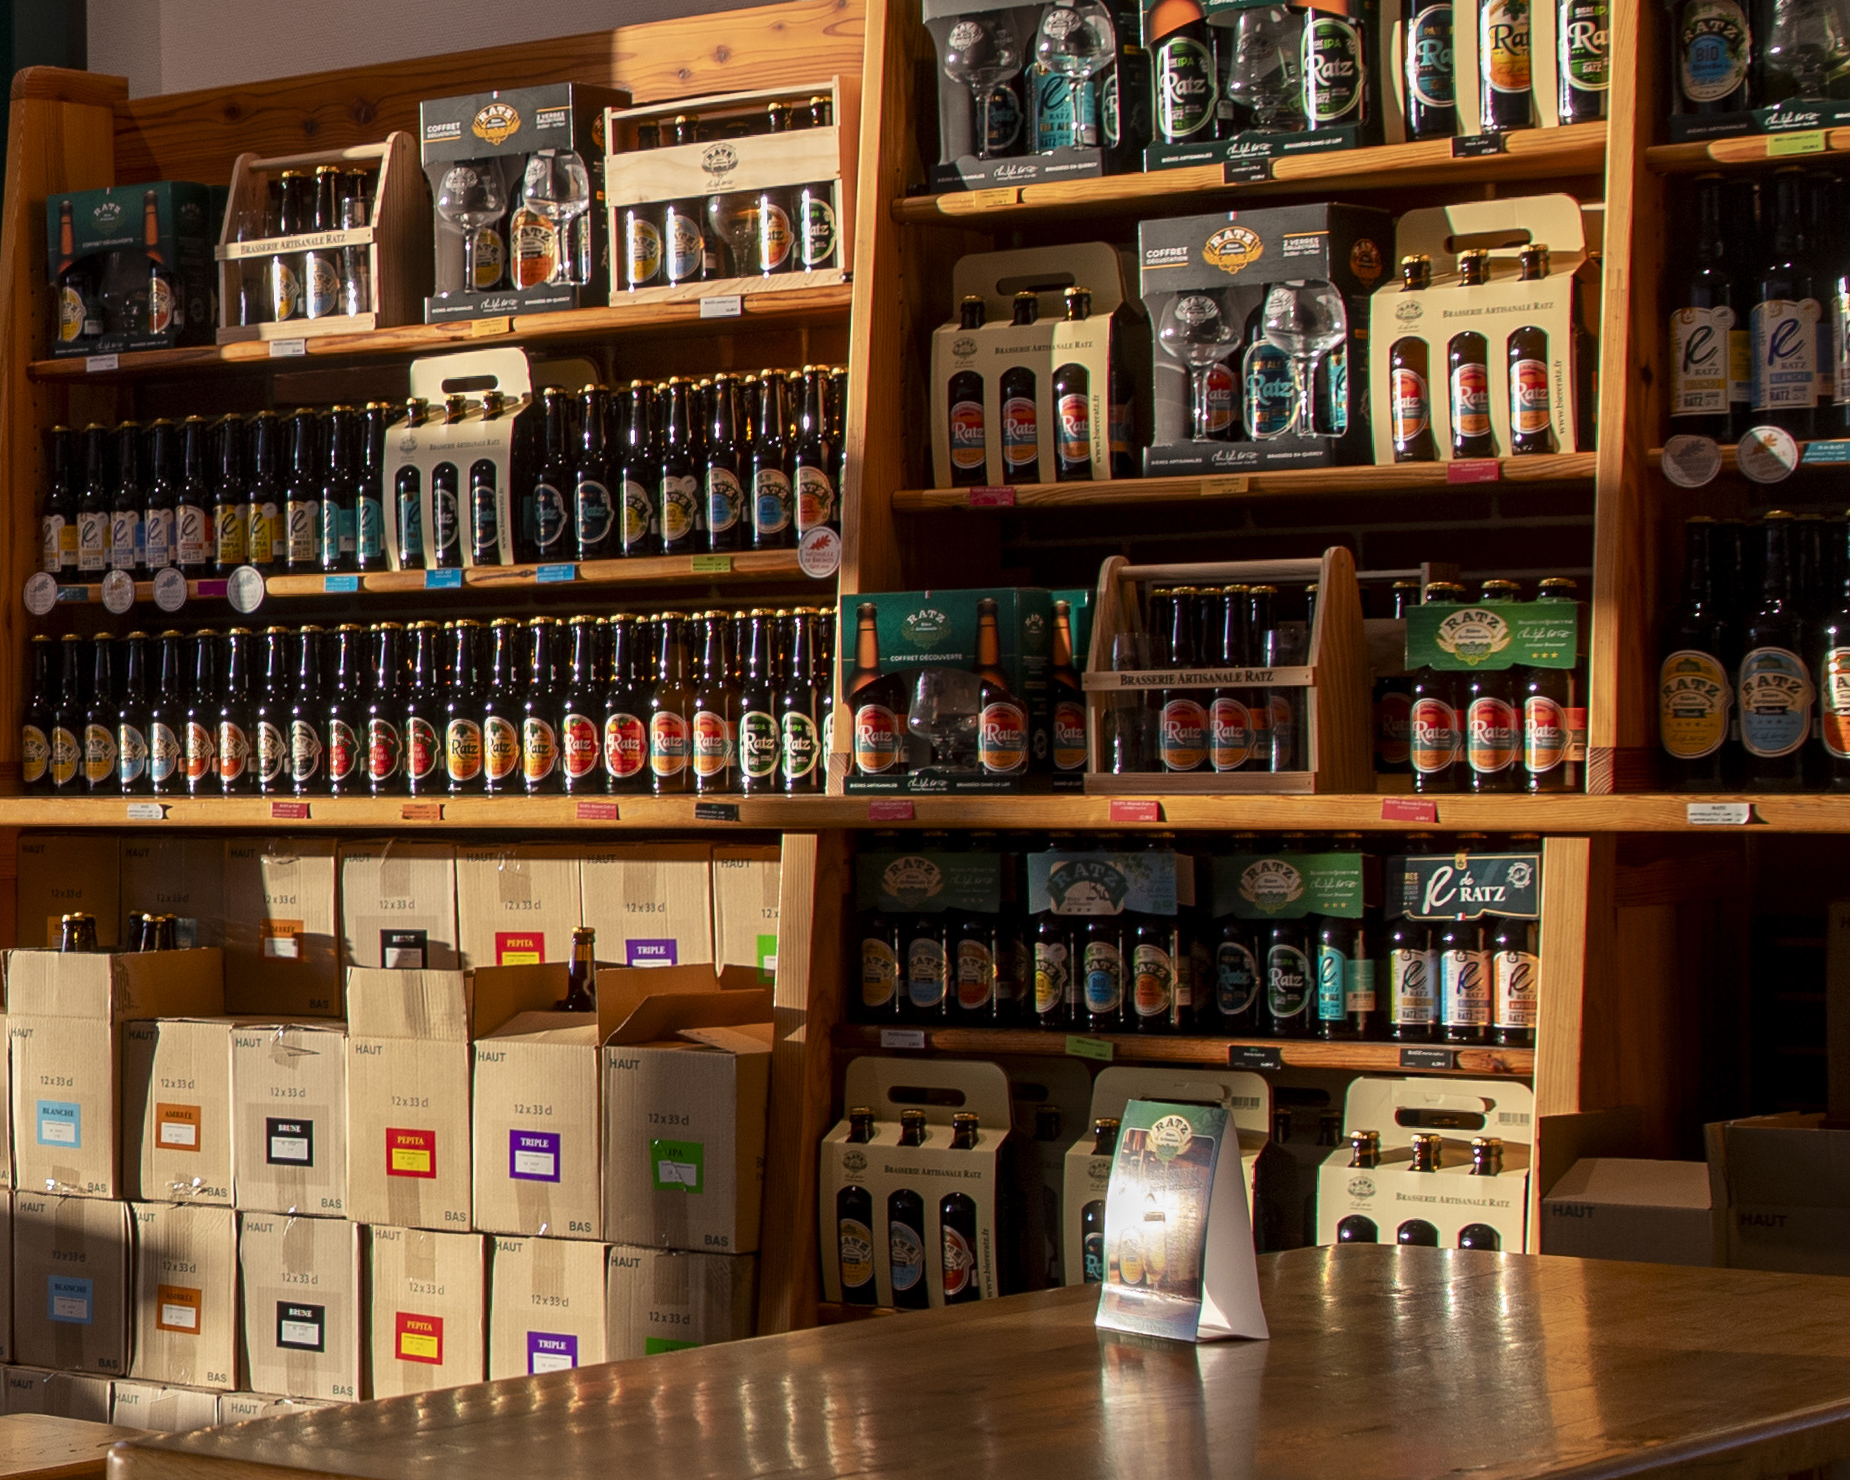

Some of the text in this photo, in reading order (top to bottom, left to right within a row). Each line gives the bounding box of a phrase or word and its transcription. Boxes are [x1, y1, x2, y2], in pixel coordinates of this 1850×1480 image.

[1685, 20, 1737, 44] RATZ
[1305, 55, 1353, 86] Ratz
[907, 609, 946, 624] RATZ
[1444, 611, 1500, 631] RATZ
[890, 653, 962, 662] COFFRET DÉCOUVERTE
[1459, 871, 1474, 885] de
[1460, 886, 1505, 902] RATZ
[356, 1045, 382, 1055] HAUT
[609, 1059, 640, 1070] HAUT
[42, 1107, 74, 1117] BLANCHE
[397, 1136, 424, 1145] PEPITA
[520, 1137, 549, 1148] TRIPLE
[445, 1212, 466, 1222] BAS
[1552, 1204, 1595, 1219] HAUT
[1740, 1214, 1787, 1227] HAUT
[705, 1235, 728, 1246] BAS
[407, 1320, 433, 1332] PEPITA
